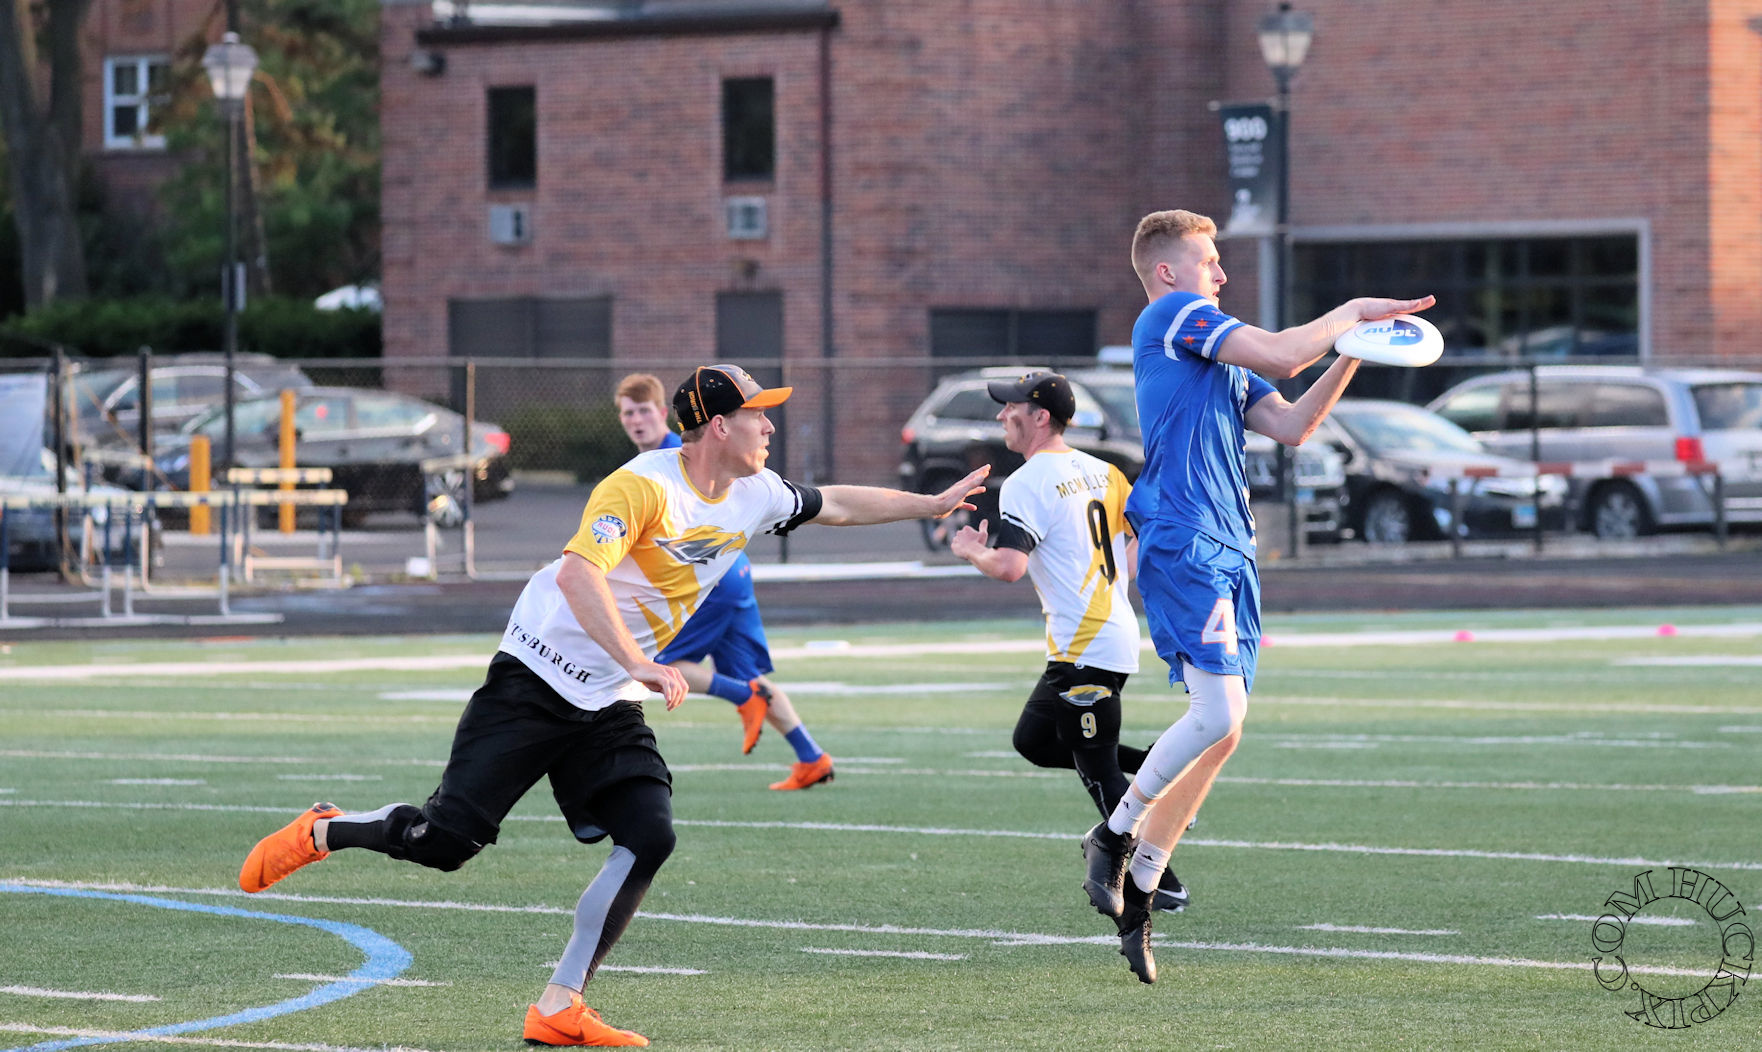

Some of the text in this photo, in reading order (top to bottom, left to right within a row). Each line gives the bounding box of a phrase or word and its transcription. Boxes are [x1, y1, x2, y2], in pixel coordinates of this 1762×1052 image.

[1363, 326, 1417, 337] AUDL
[1087, 498, 1116, 586] 9
[510, 621, 592, 684] TSBURGH
[1201, 598, 1239, 655] 4
[1080, 712, 1097, 739] 9
